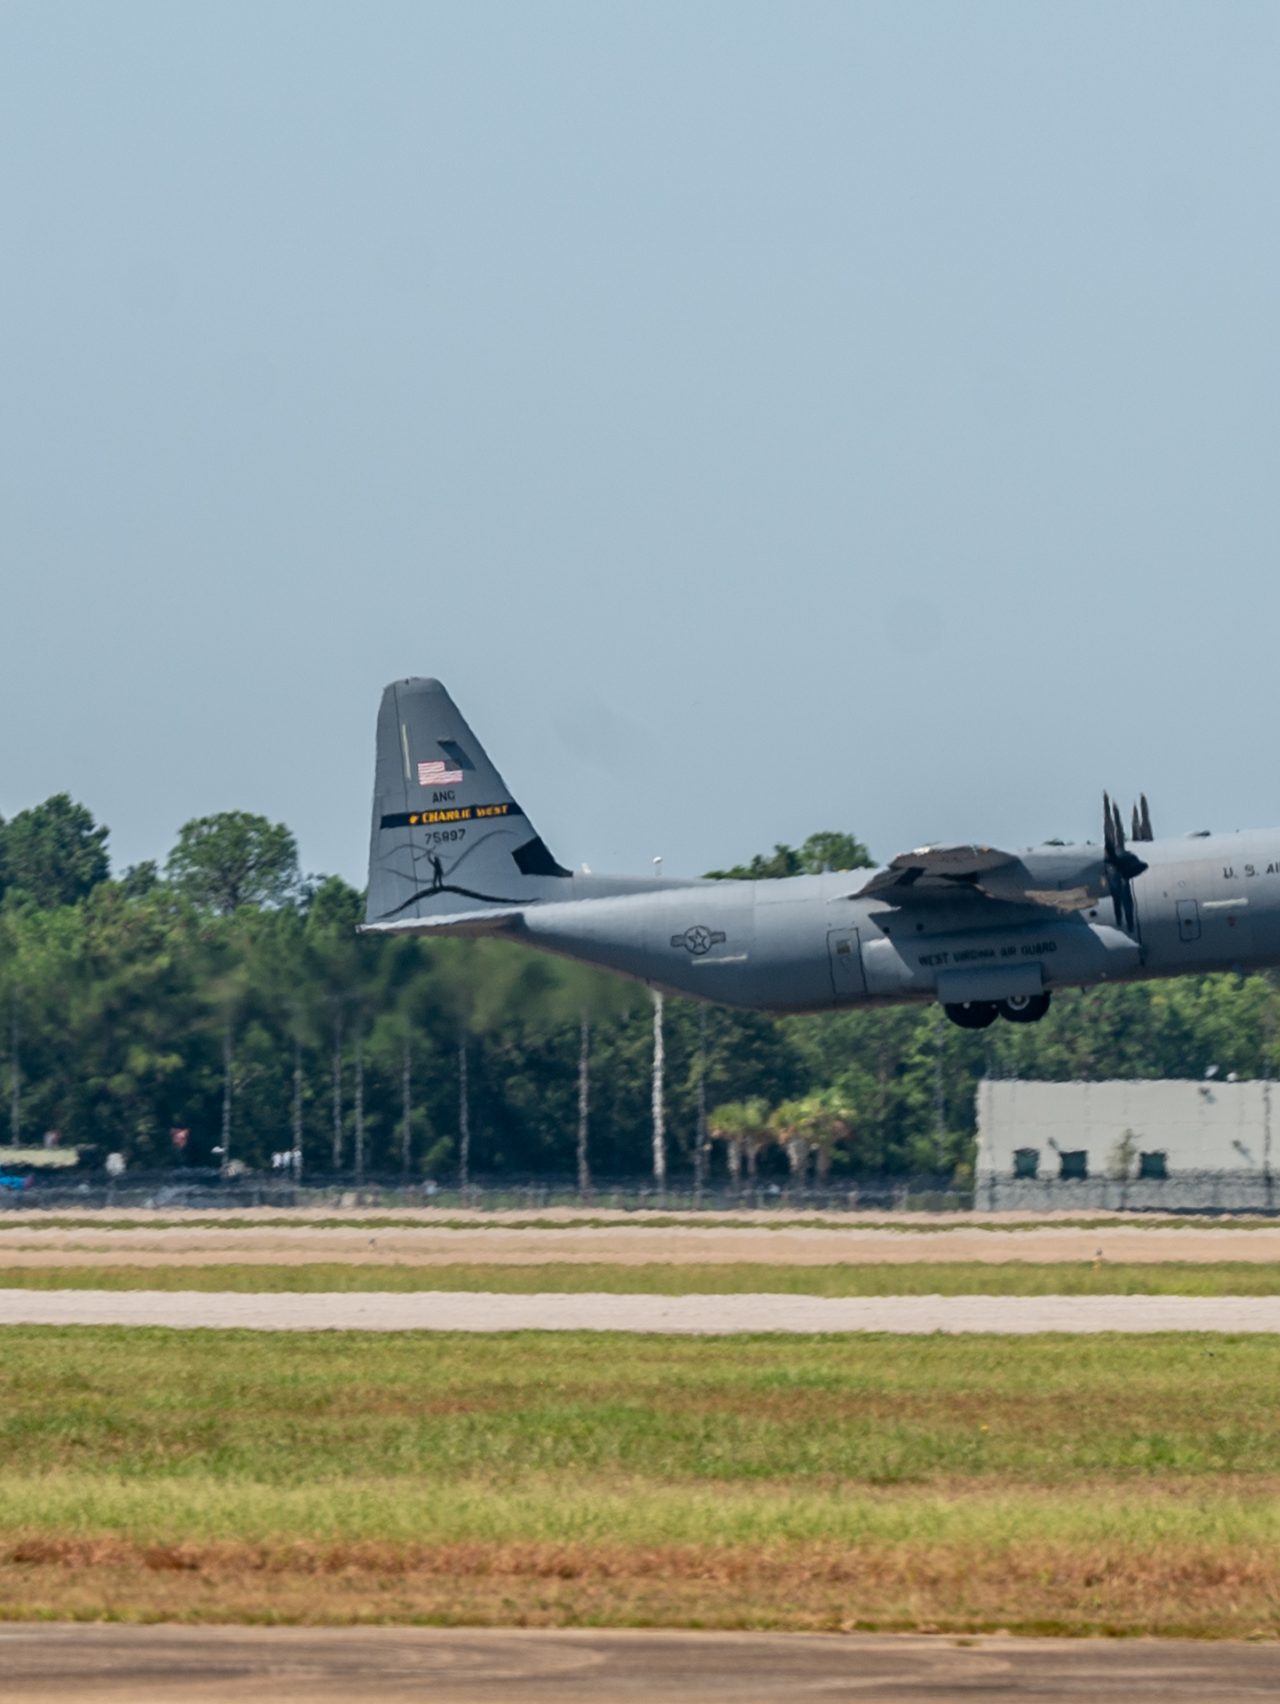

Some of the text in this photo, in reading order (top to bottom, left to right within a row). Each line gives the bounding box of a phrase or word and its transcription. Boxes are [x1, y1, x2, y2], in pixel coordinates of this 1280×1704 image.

[432, 790, 455, 803] ANG
[422, 804, 508, 824] CHARLIE WEST
[918, 952, 949, 966] WEST
[1001, 946, 1017, 957] AIR
[1021, 941, 1057, 955] GUARD
